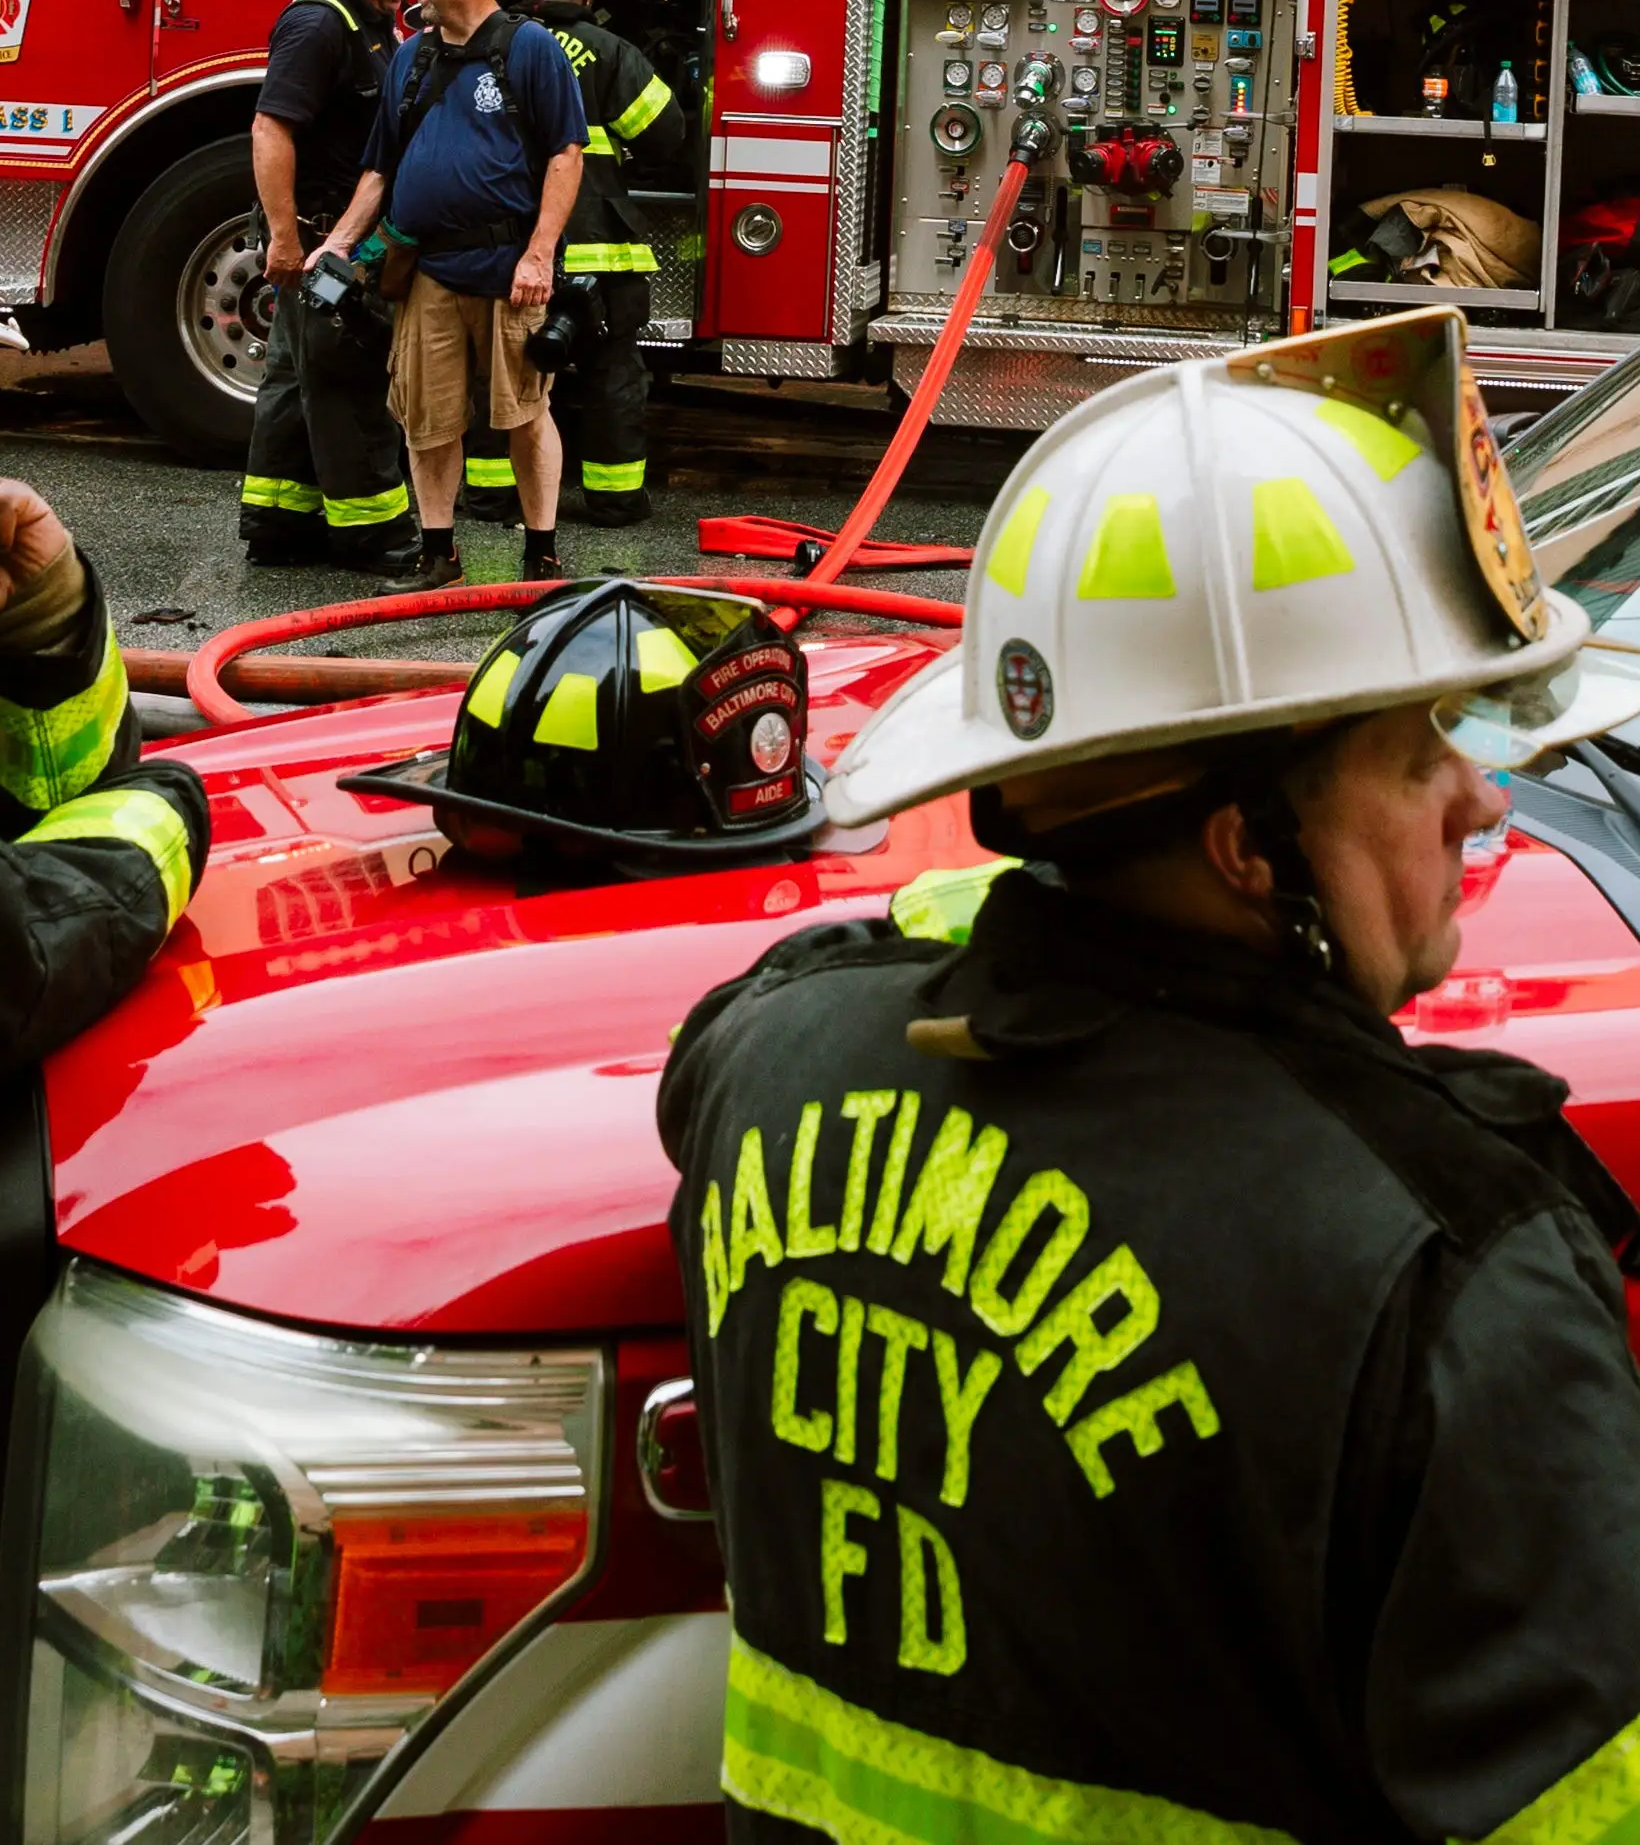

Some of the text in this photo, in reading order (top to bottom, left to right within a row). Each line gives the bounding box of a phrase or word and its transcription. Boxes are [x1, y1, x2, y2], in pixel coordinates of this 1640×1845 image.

[705, 681, 798, 731] BALTIMORE CITY
[711, 660, 741, 689] FIRE
[754, 782, 784, 805] AIDE
[700, 1089, 1221, 1499] BALTIMORE
[771, 1276, 1003, 1508] CITY
[821, 1478, 967, 1677] FD
